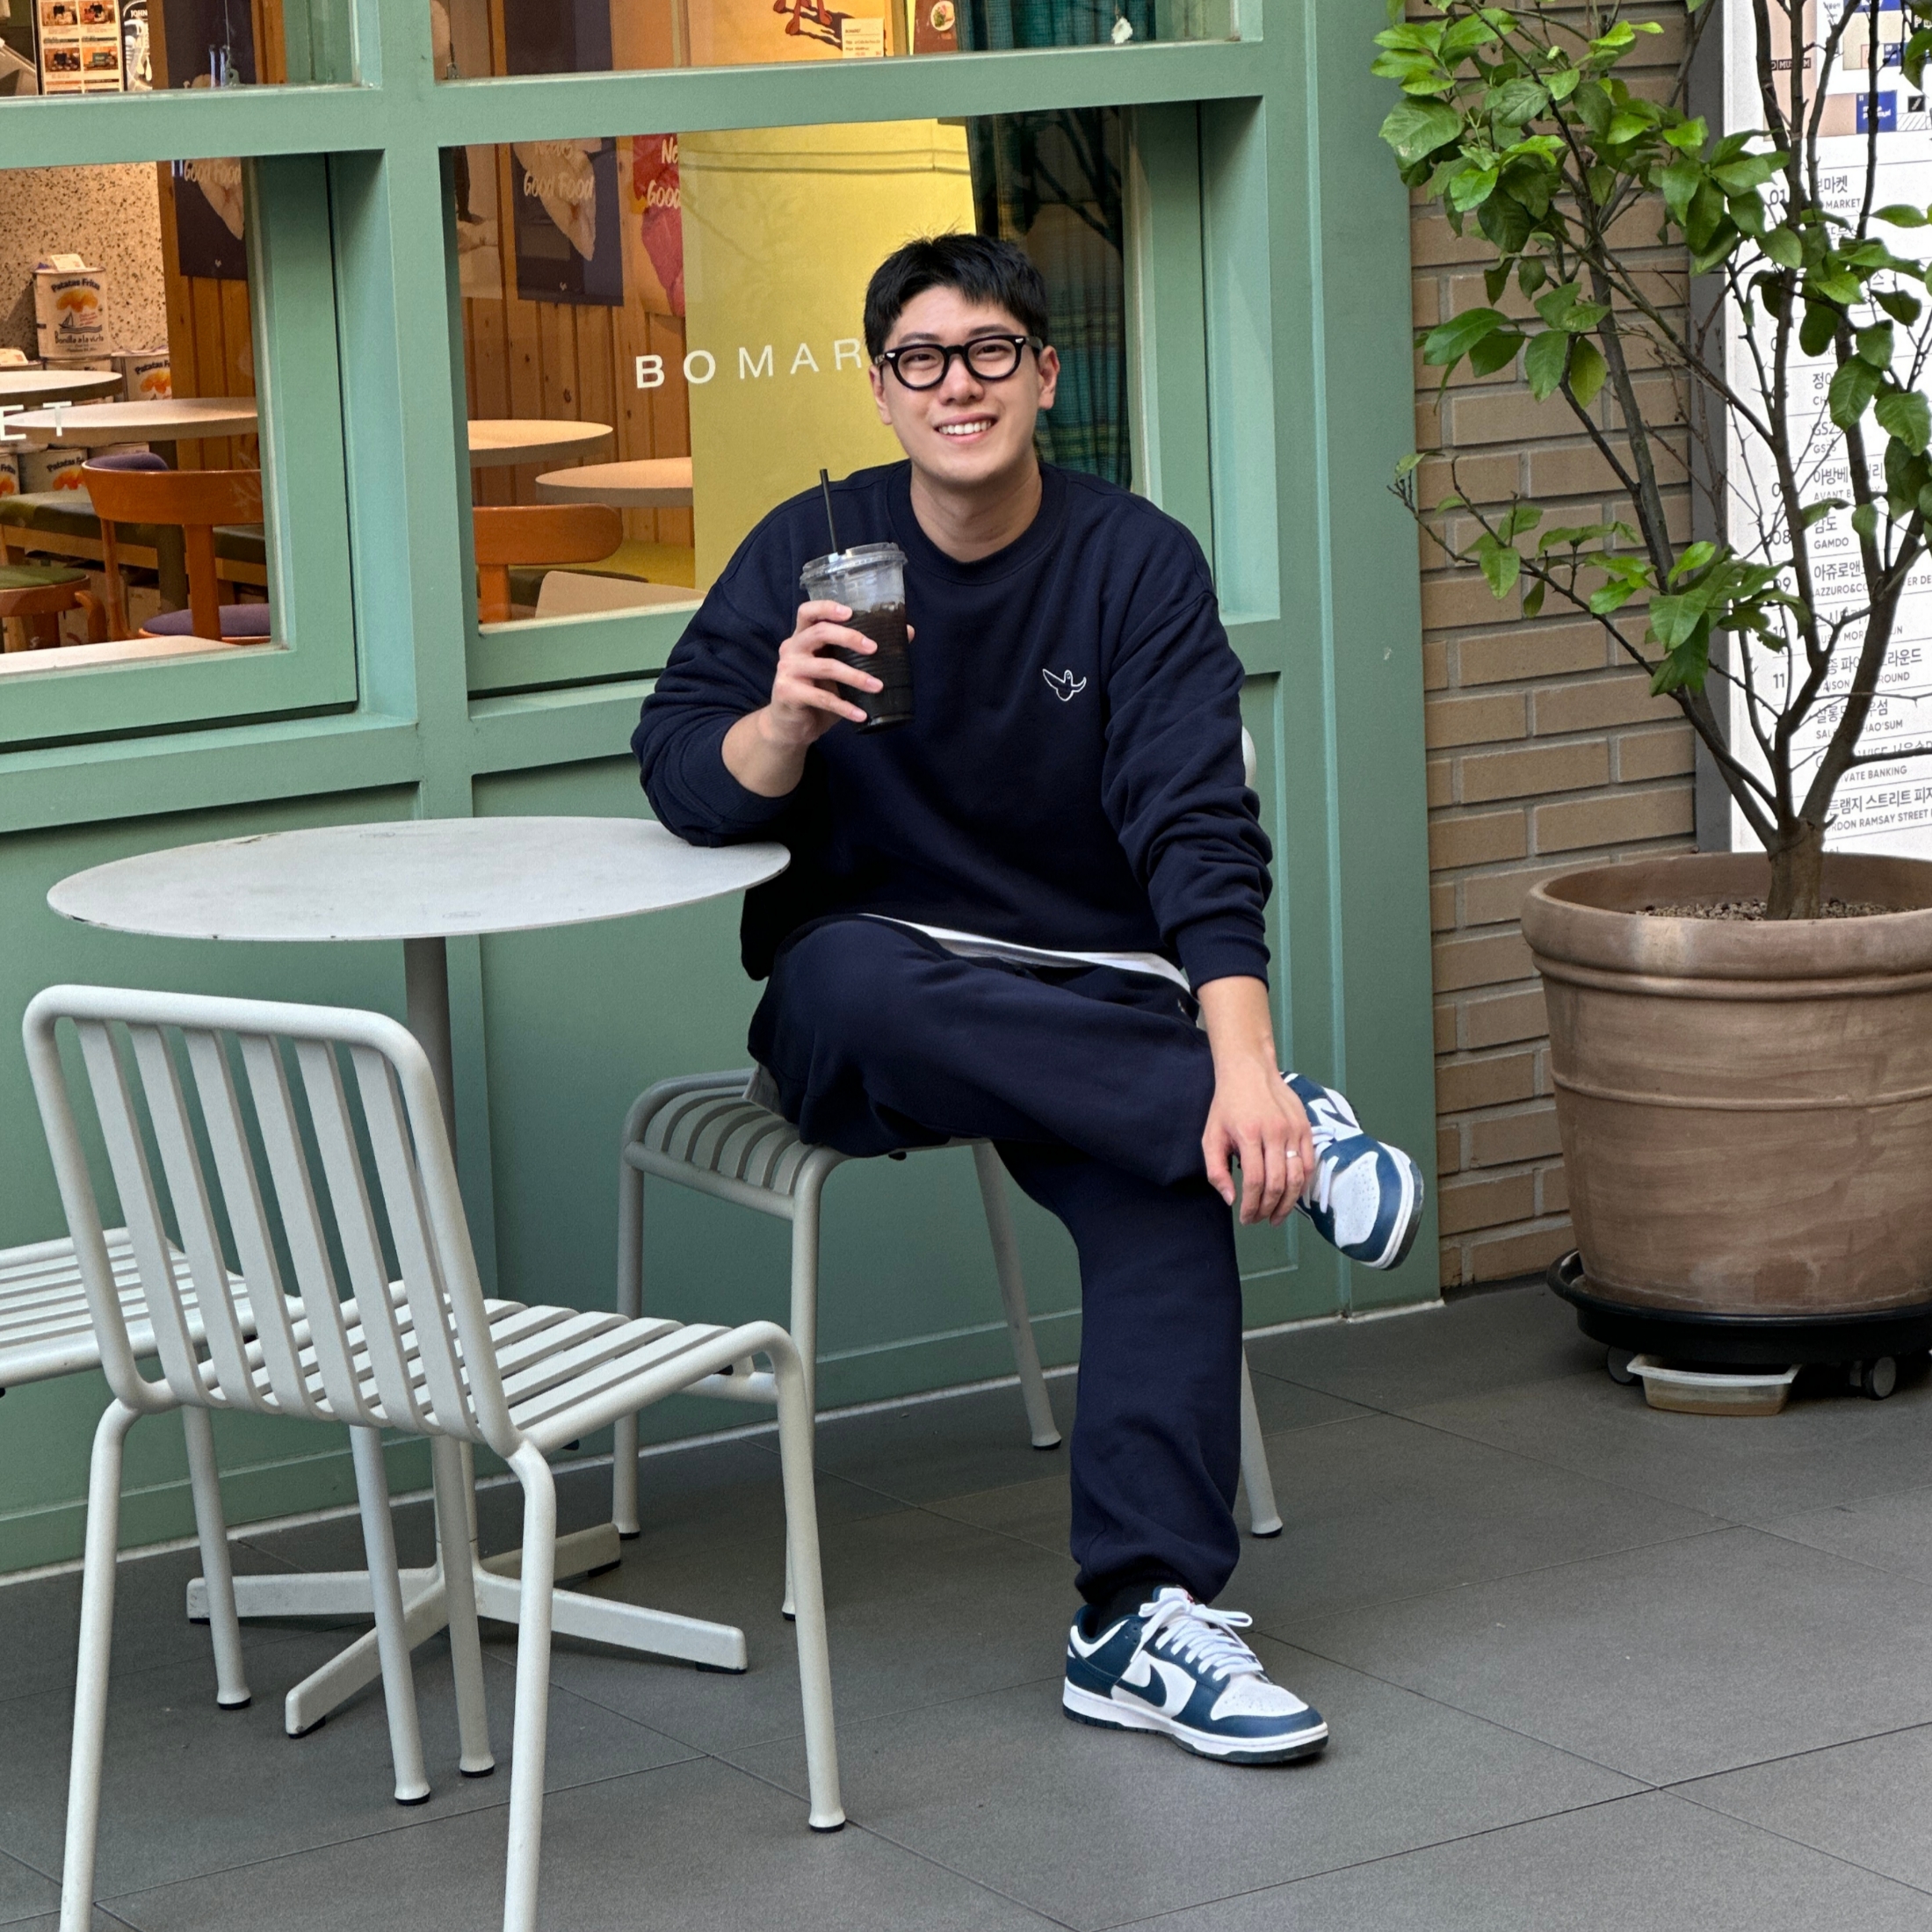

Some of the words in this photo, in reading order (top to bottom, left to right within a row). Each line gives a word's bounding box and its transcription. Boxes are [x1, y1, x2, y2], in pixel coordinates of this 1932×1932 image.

[524, 170, 554, 198] Good
[557, 171, 595, 201] Food
[1769, 189, 1785, 206] 01
[1826, 198, 1861, 209] MARKET
[51, 279, 81, 293] Patatas
[82, 278, 100, 291] Fritas
[135, 360, 163, 375] Patatas
[1812, 422, 1843, 437] GS2
[1813, 443, 1836, 454] GS5
[47, 458, 76, 473] Patatas
[1772, 530, 1791, 546] 08
[1813, 536, 1849, 550] GAMDO
[1814, 560, 1865, 582] 아쥬로앤
[1773, 673, 1785, 689] 11
[1868, 765, 1907, 779] BANKING
[1865, 790, 1912, 810] 스트리트
[1859, 814, 1895, 829] RAMSAY
[1898, 807, 1928, 822] STREET
